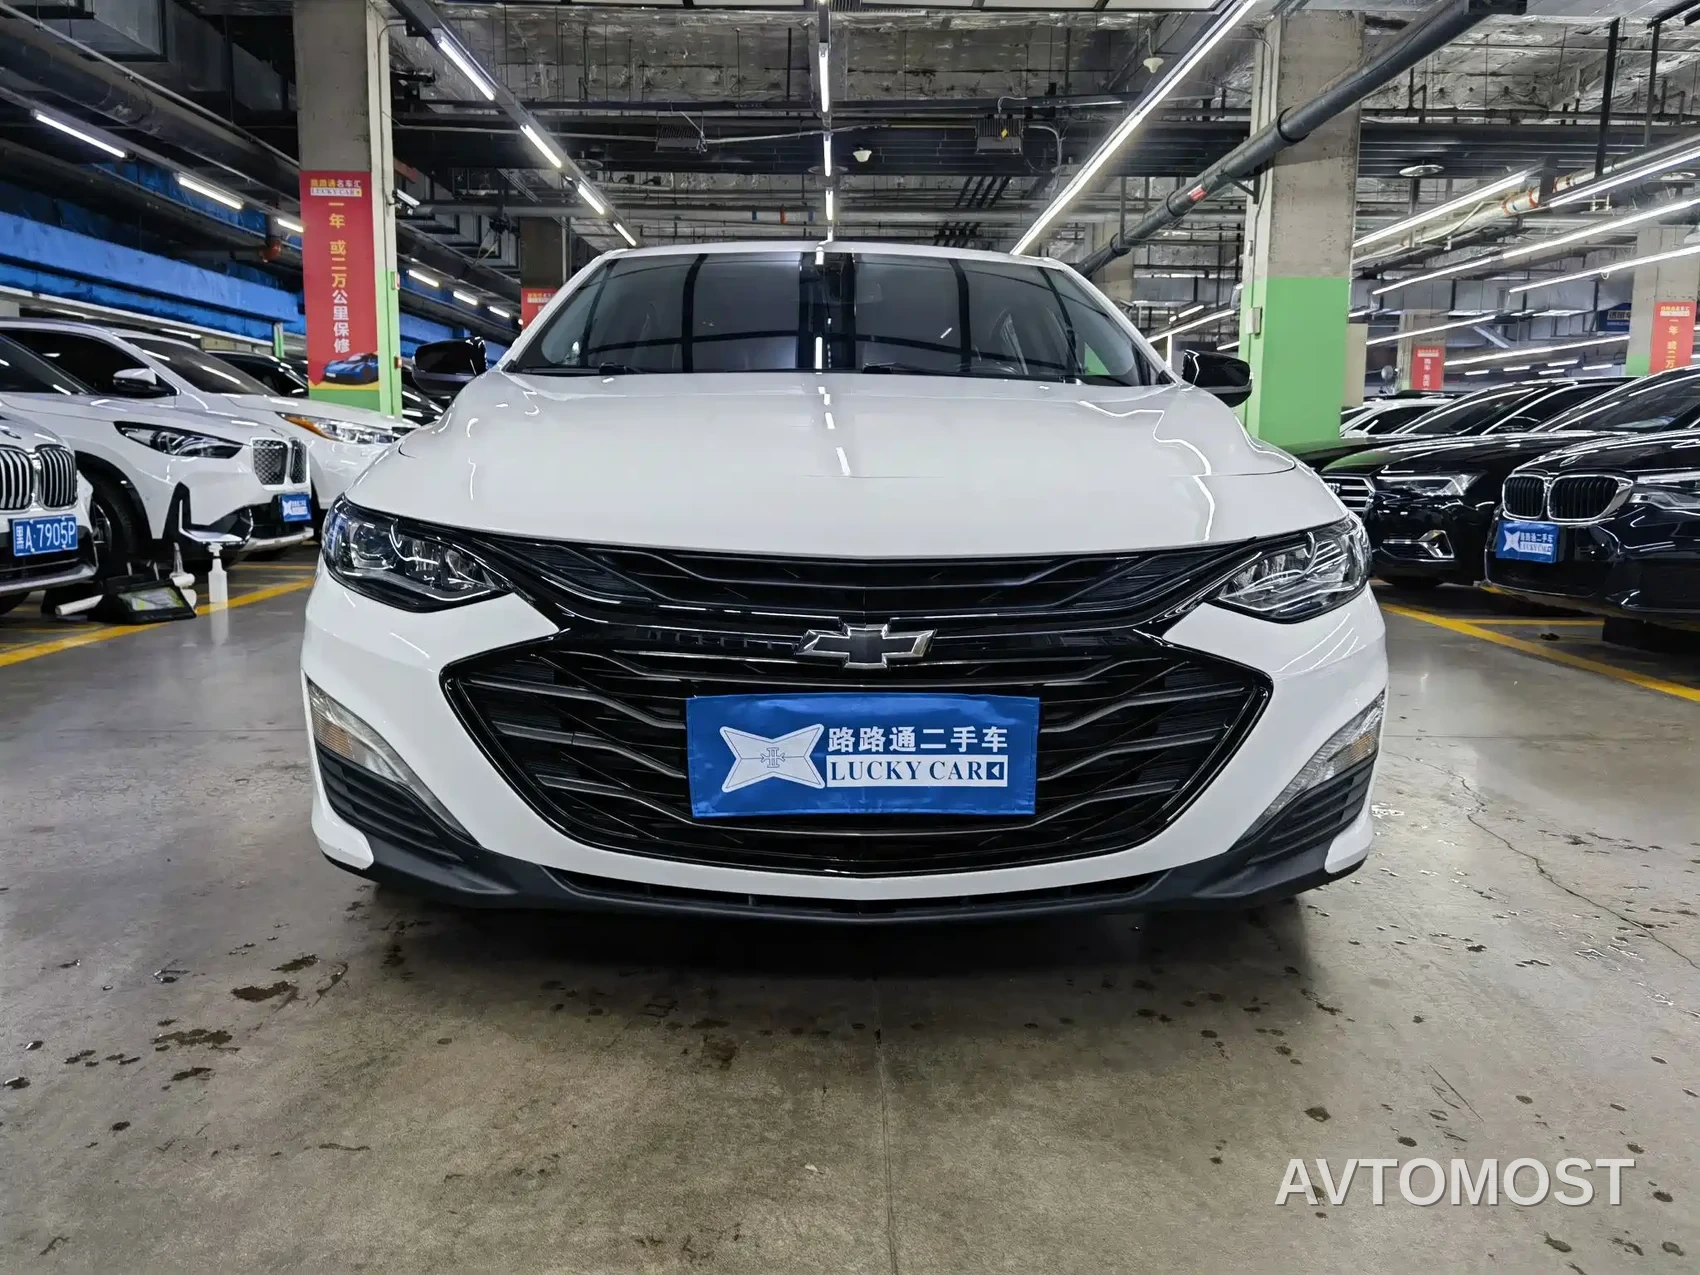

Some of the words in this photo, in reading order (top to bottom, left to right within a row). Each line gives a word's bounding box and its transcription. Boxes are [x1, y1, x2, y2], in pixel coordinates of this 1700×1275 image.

[328, 202, 346, 228] 一年
[329, 240, 350, 353] 或二万公里保修
[827, 726, 1008, 753] 路路通二手车
[830, 760, 921, 781] LUCKY
[929, 760, 983, 781] CAR
